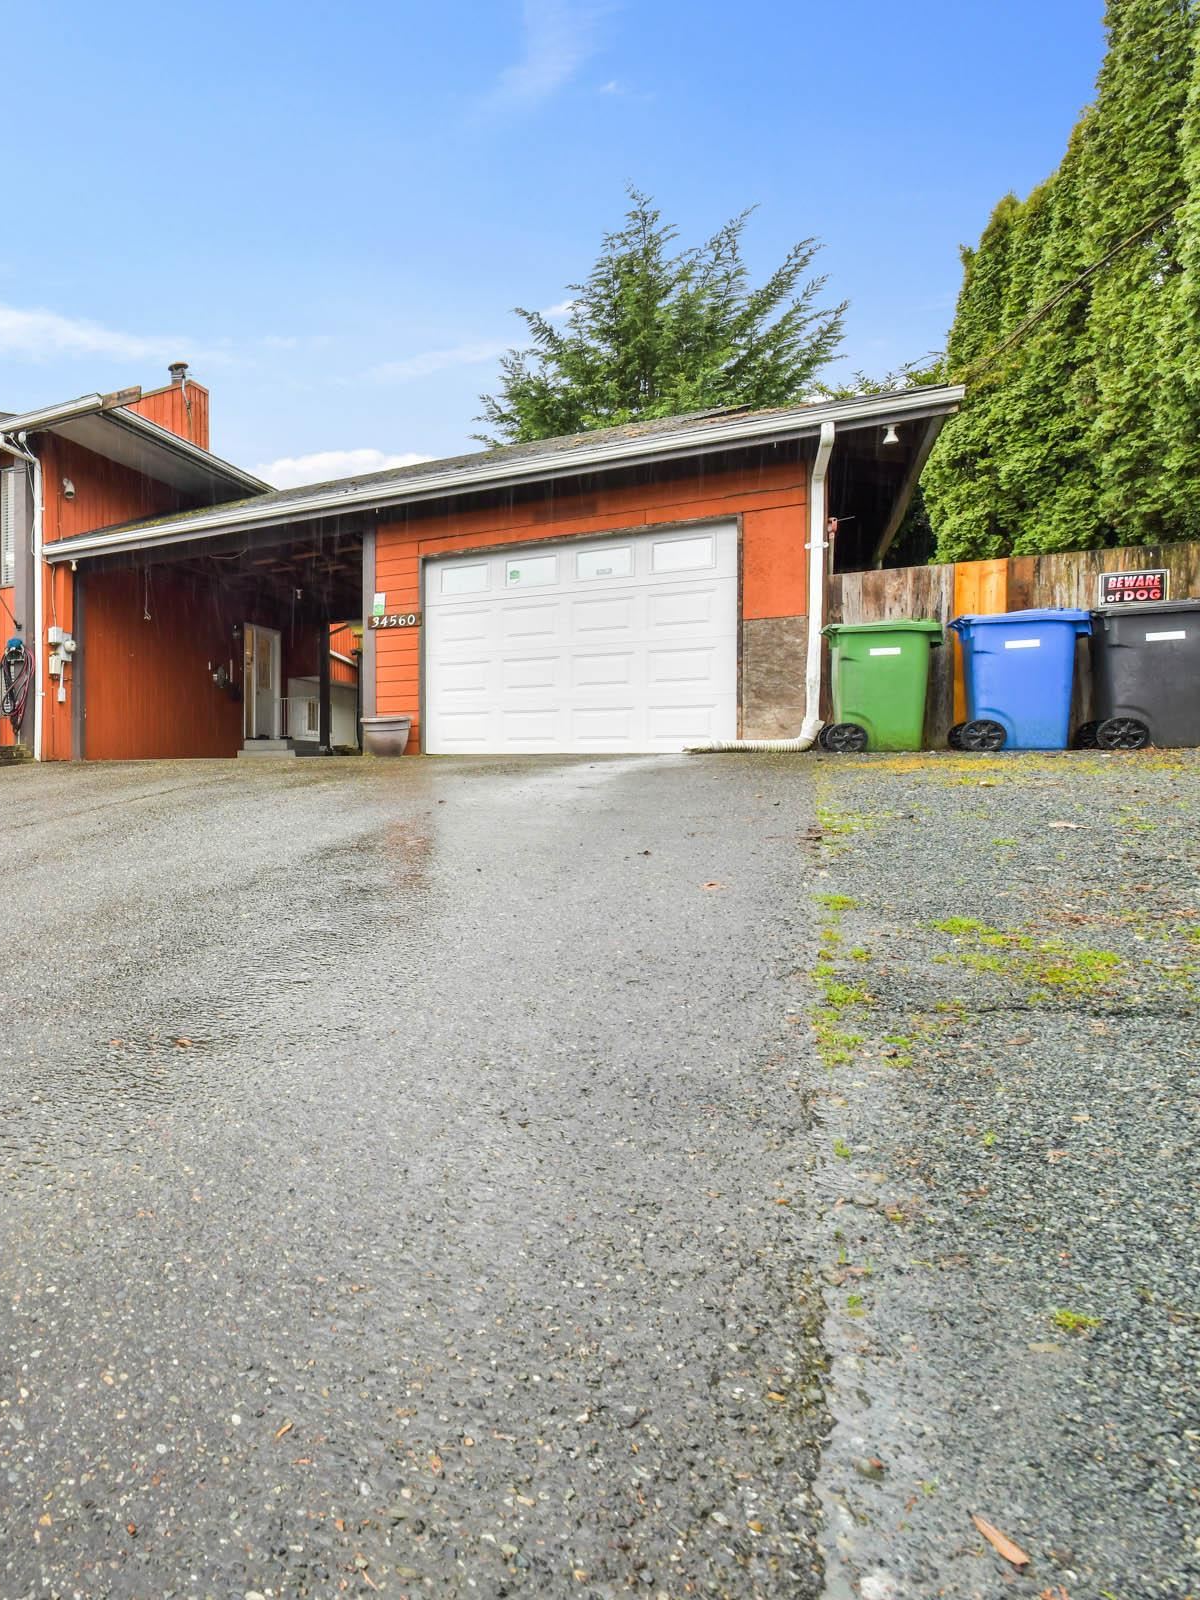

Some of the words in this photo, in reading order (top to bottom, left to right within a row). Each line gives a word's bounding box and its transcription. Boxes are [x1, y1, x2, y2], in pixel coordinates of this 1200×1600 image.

[1108, 575, 1161, 588] BEWARE
[1106, 592, 1120, 602] of
[1123, 589, 1161, 601] DOG
[371, 614, 416, 628] 34560
